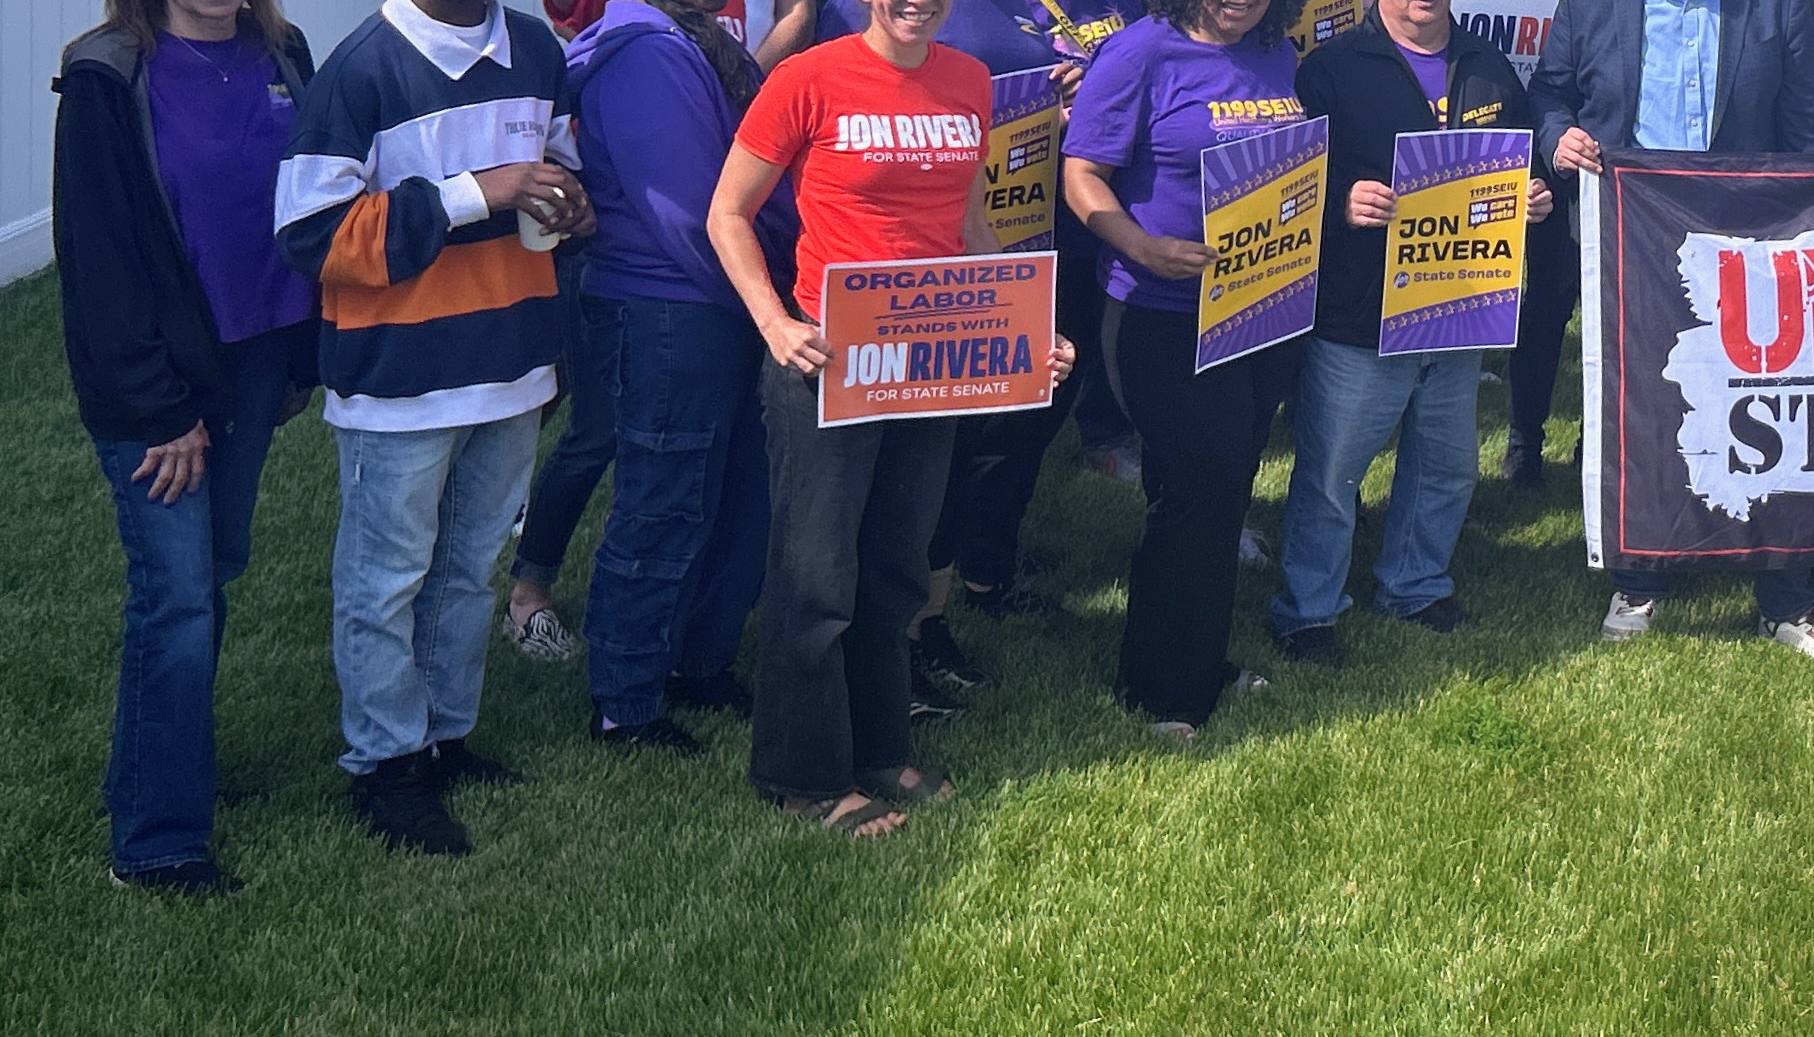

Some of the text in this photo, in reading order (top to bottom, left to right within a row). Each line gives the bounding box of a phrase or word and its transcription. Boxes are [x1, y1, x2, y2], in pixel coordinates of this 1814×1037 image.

[1207, 97, 1304, 118] 1199SEIU
[835, 115, 896, 151] JON
[863, 150, 979, 163] FOR STATE SENATE
[1470, 182, 1518, 197] 1199SEIU
[996, 213, 1045, 228] Senate
[1399, 215, 1459, 239] JON
[1218, 218, 1272, 253] JON
[1214, 228, 1312, 279] RIVERA
[1398, 239, 1513, 265] RIVERA
[844, 264, 1037, 291] ORGANIZED
[1228, 256, 1311, 292] State Senate
[1414, 268, 1511, 283] State Senate
[890, 290, 996, 311] LABOR
[878, 318, 1010, 336] STANDS WITH
[866, 382, 1010, 402] FOR STATE SENATE
